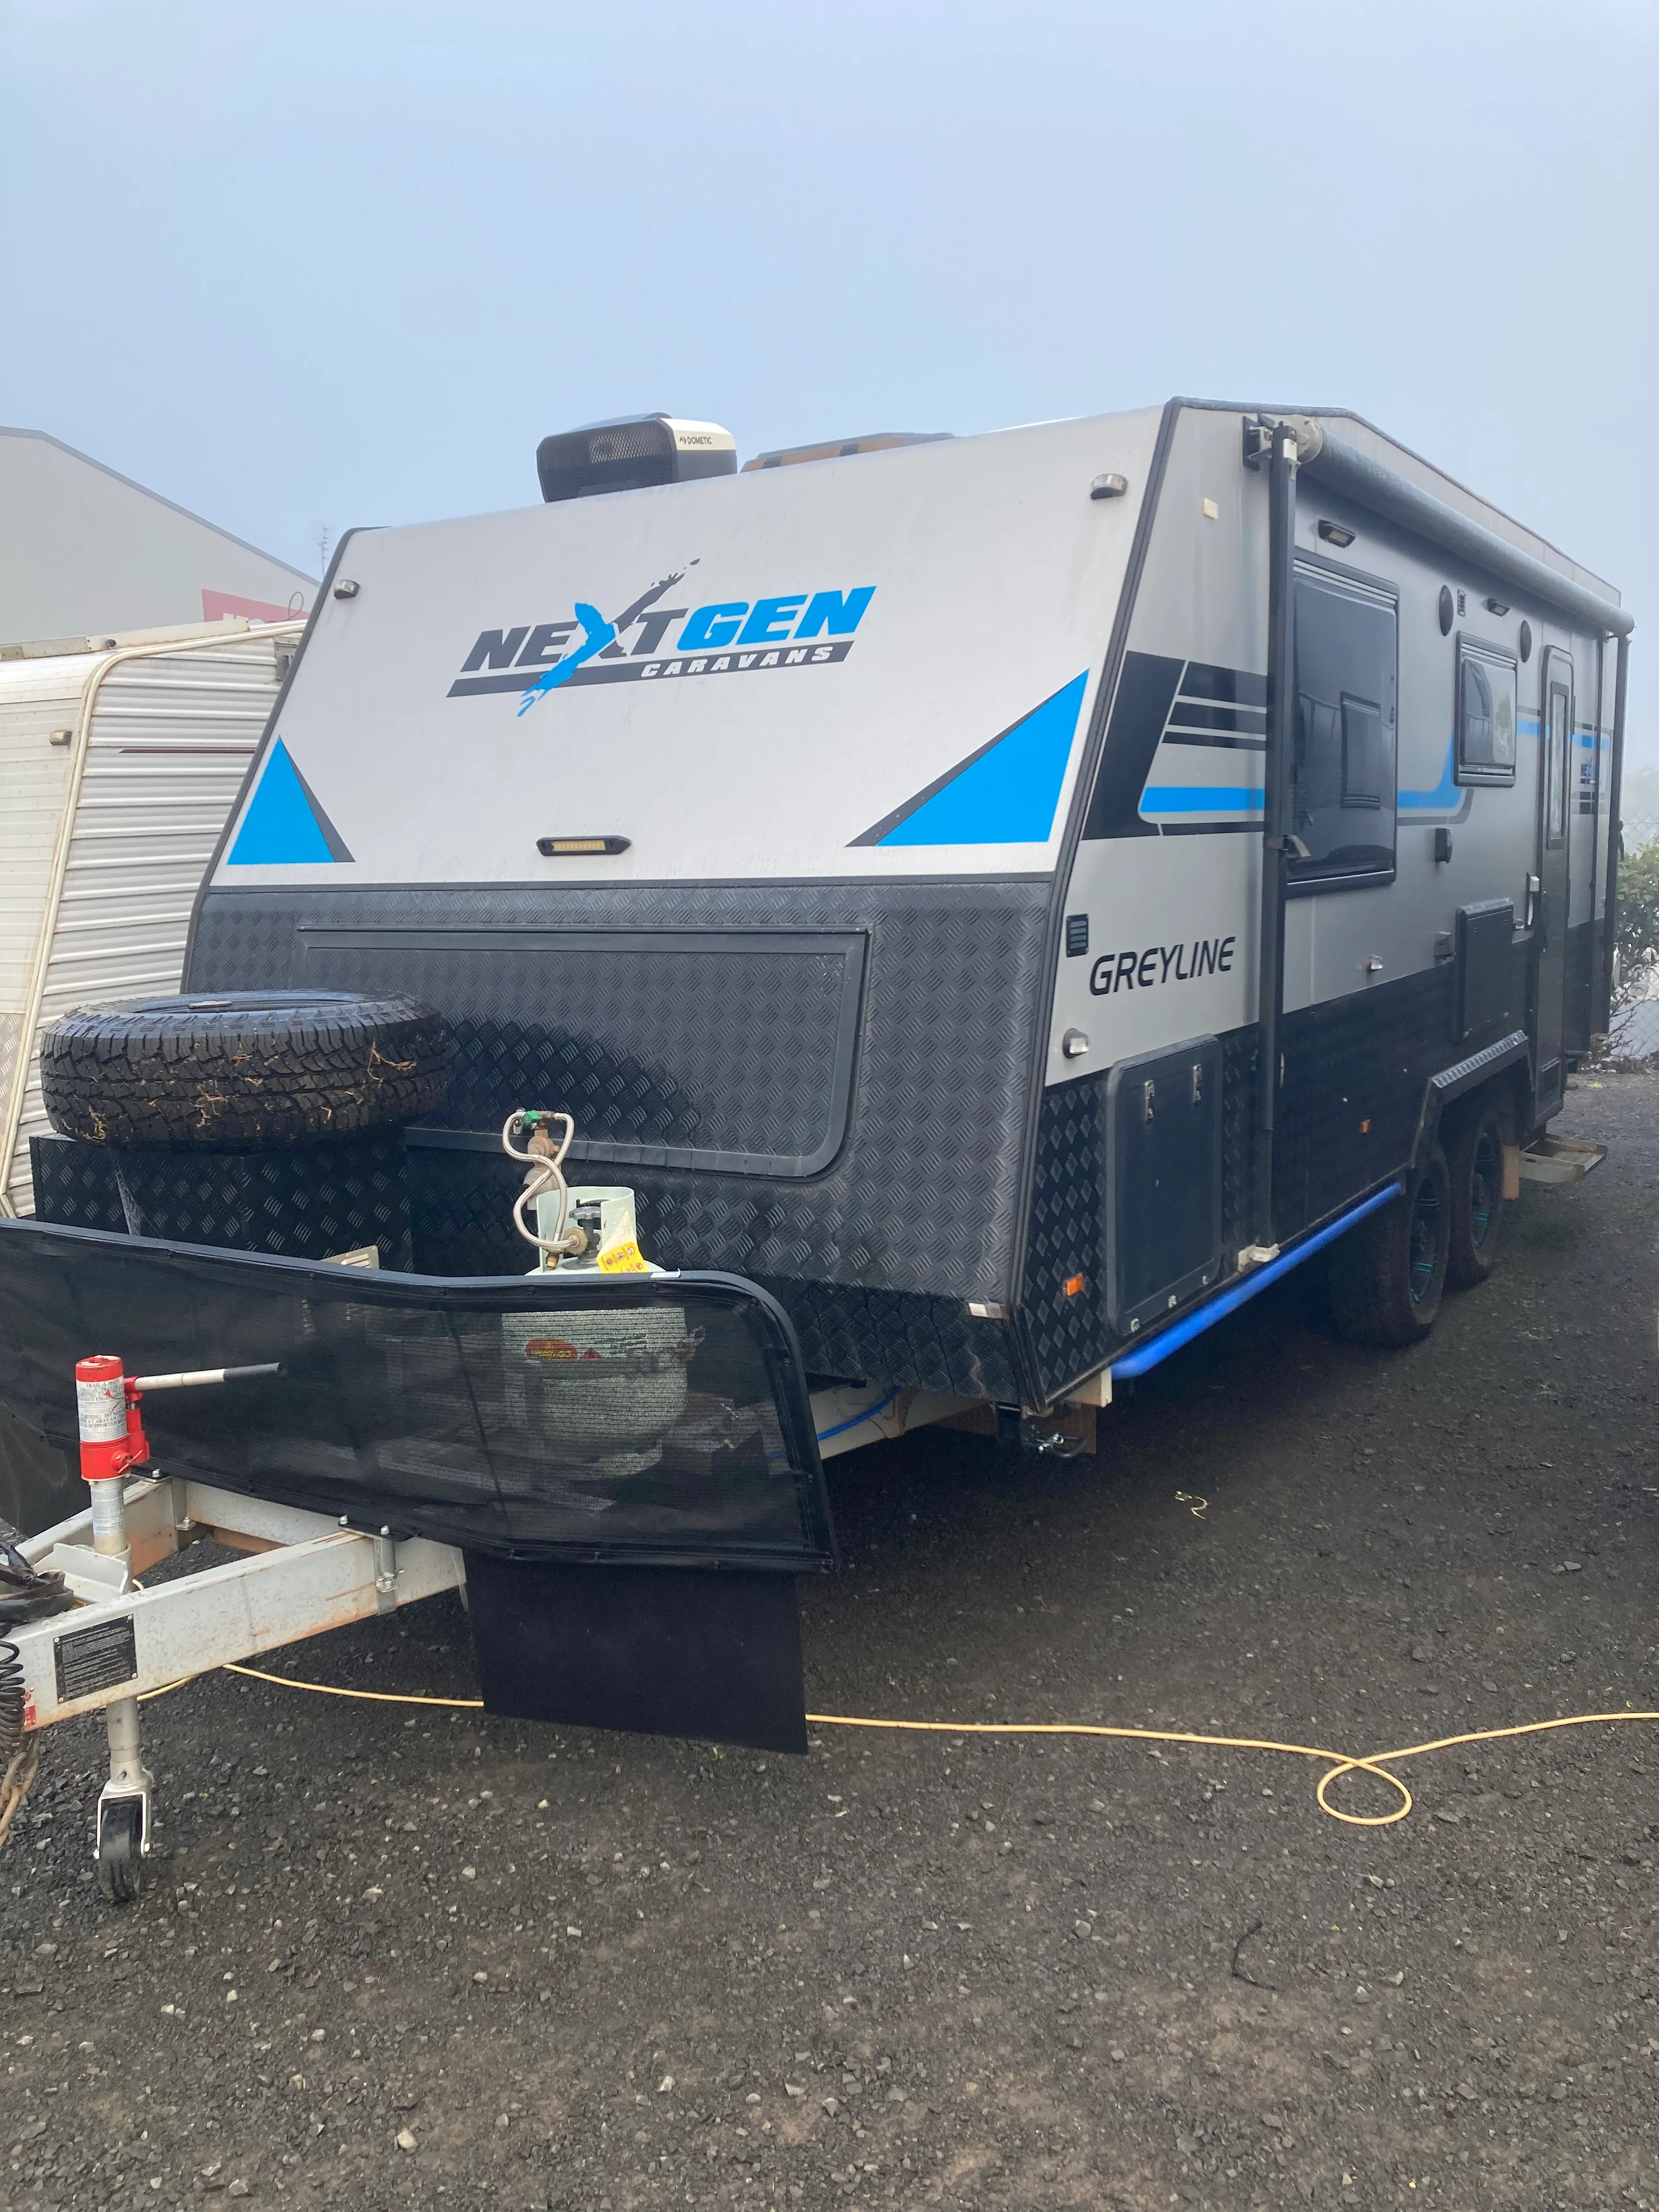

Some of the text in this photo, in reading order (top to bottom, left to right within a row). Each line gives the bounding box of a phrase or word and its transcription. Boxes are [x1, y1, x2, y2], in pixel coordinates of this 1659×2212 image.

[687, 436, 712, 444] DOMETIC
[641, 646, 832, 678] CARAVANS
[1090, 936, 1236, 996] GREYLINE
